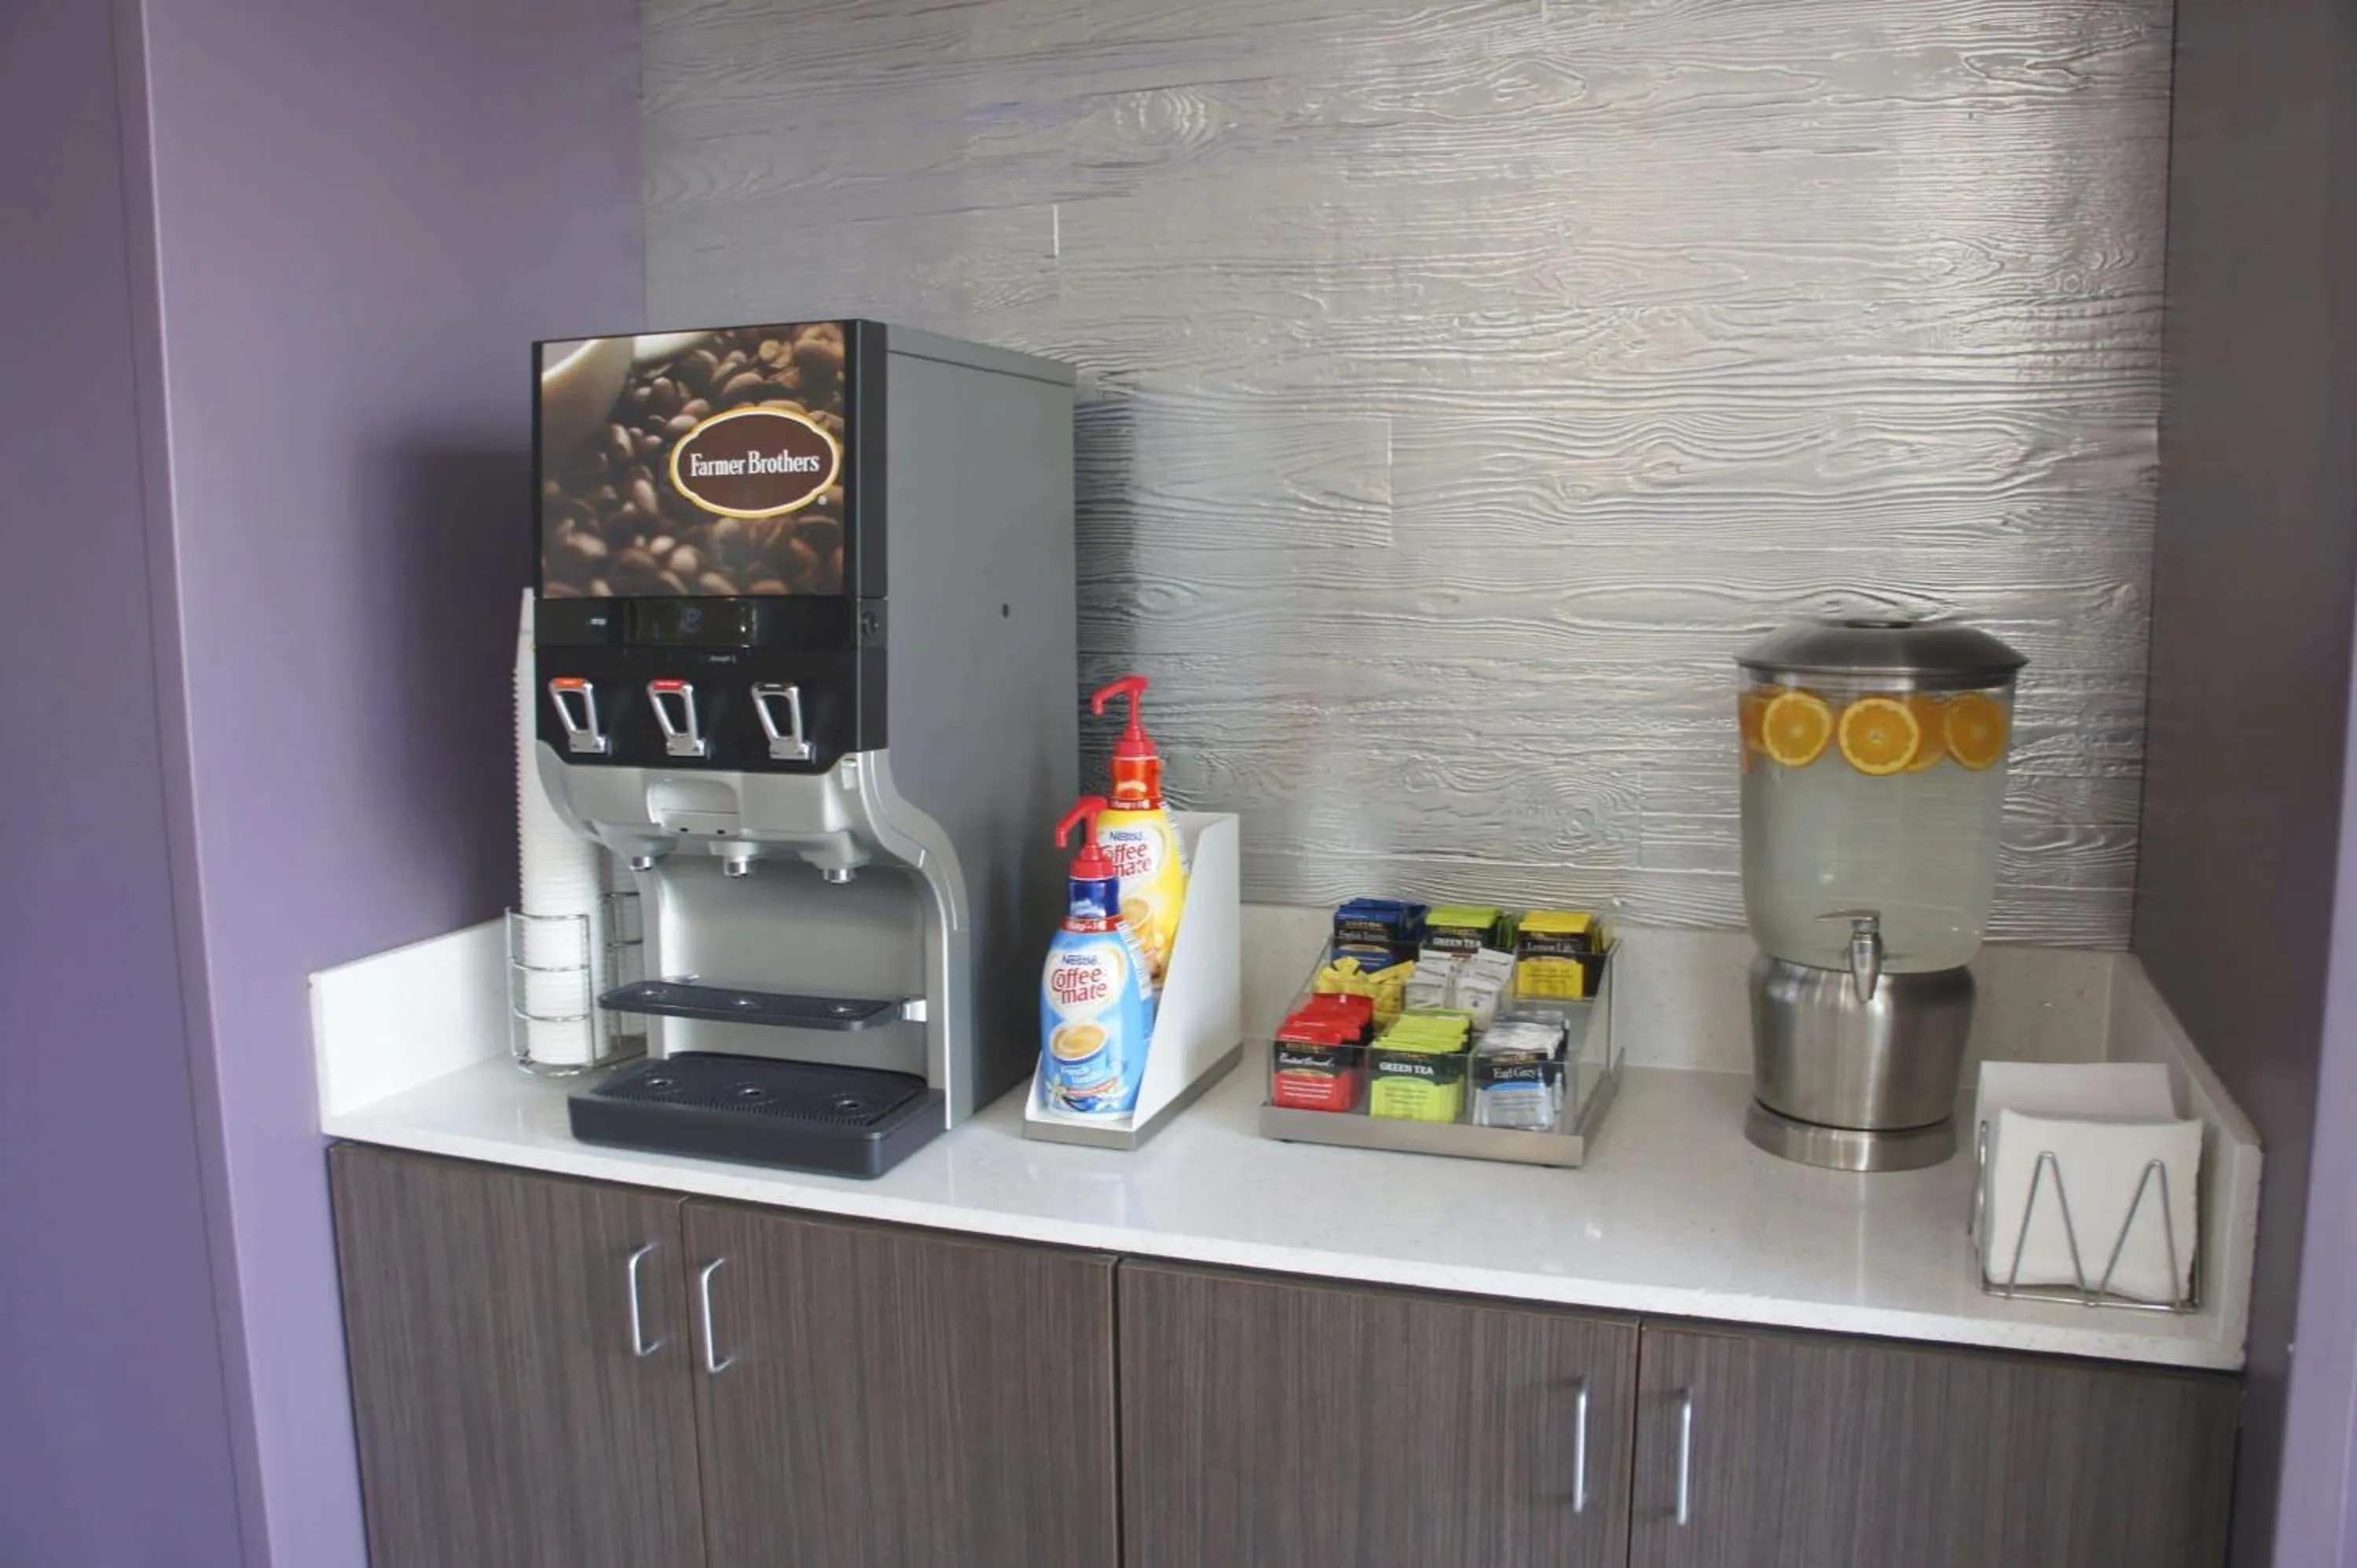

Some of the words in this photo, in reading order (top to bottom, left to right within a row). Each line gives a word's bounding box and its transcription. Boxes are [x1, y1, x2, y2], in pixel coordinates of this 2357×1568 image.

[690, 452, 746, 477] Farmer
[747, 449, 819, 474] Brothers
[1050, 967, 1103, 993] Coffee
[1061, 983, 1108, 1005] mate
[1379, 1061, 1412, 1073] GREEN
[1413, 1064, 1434, 1075] TEA
